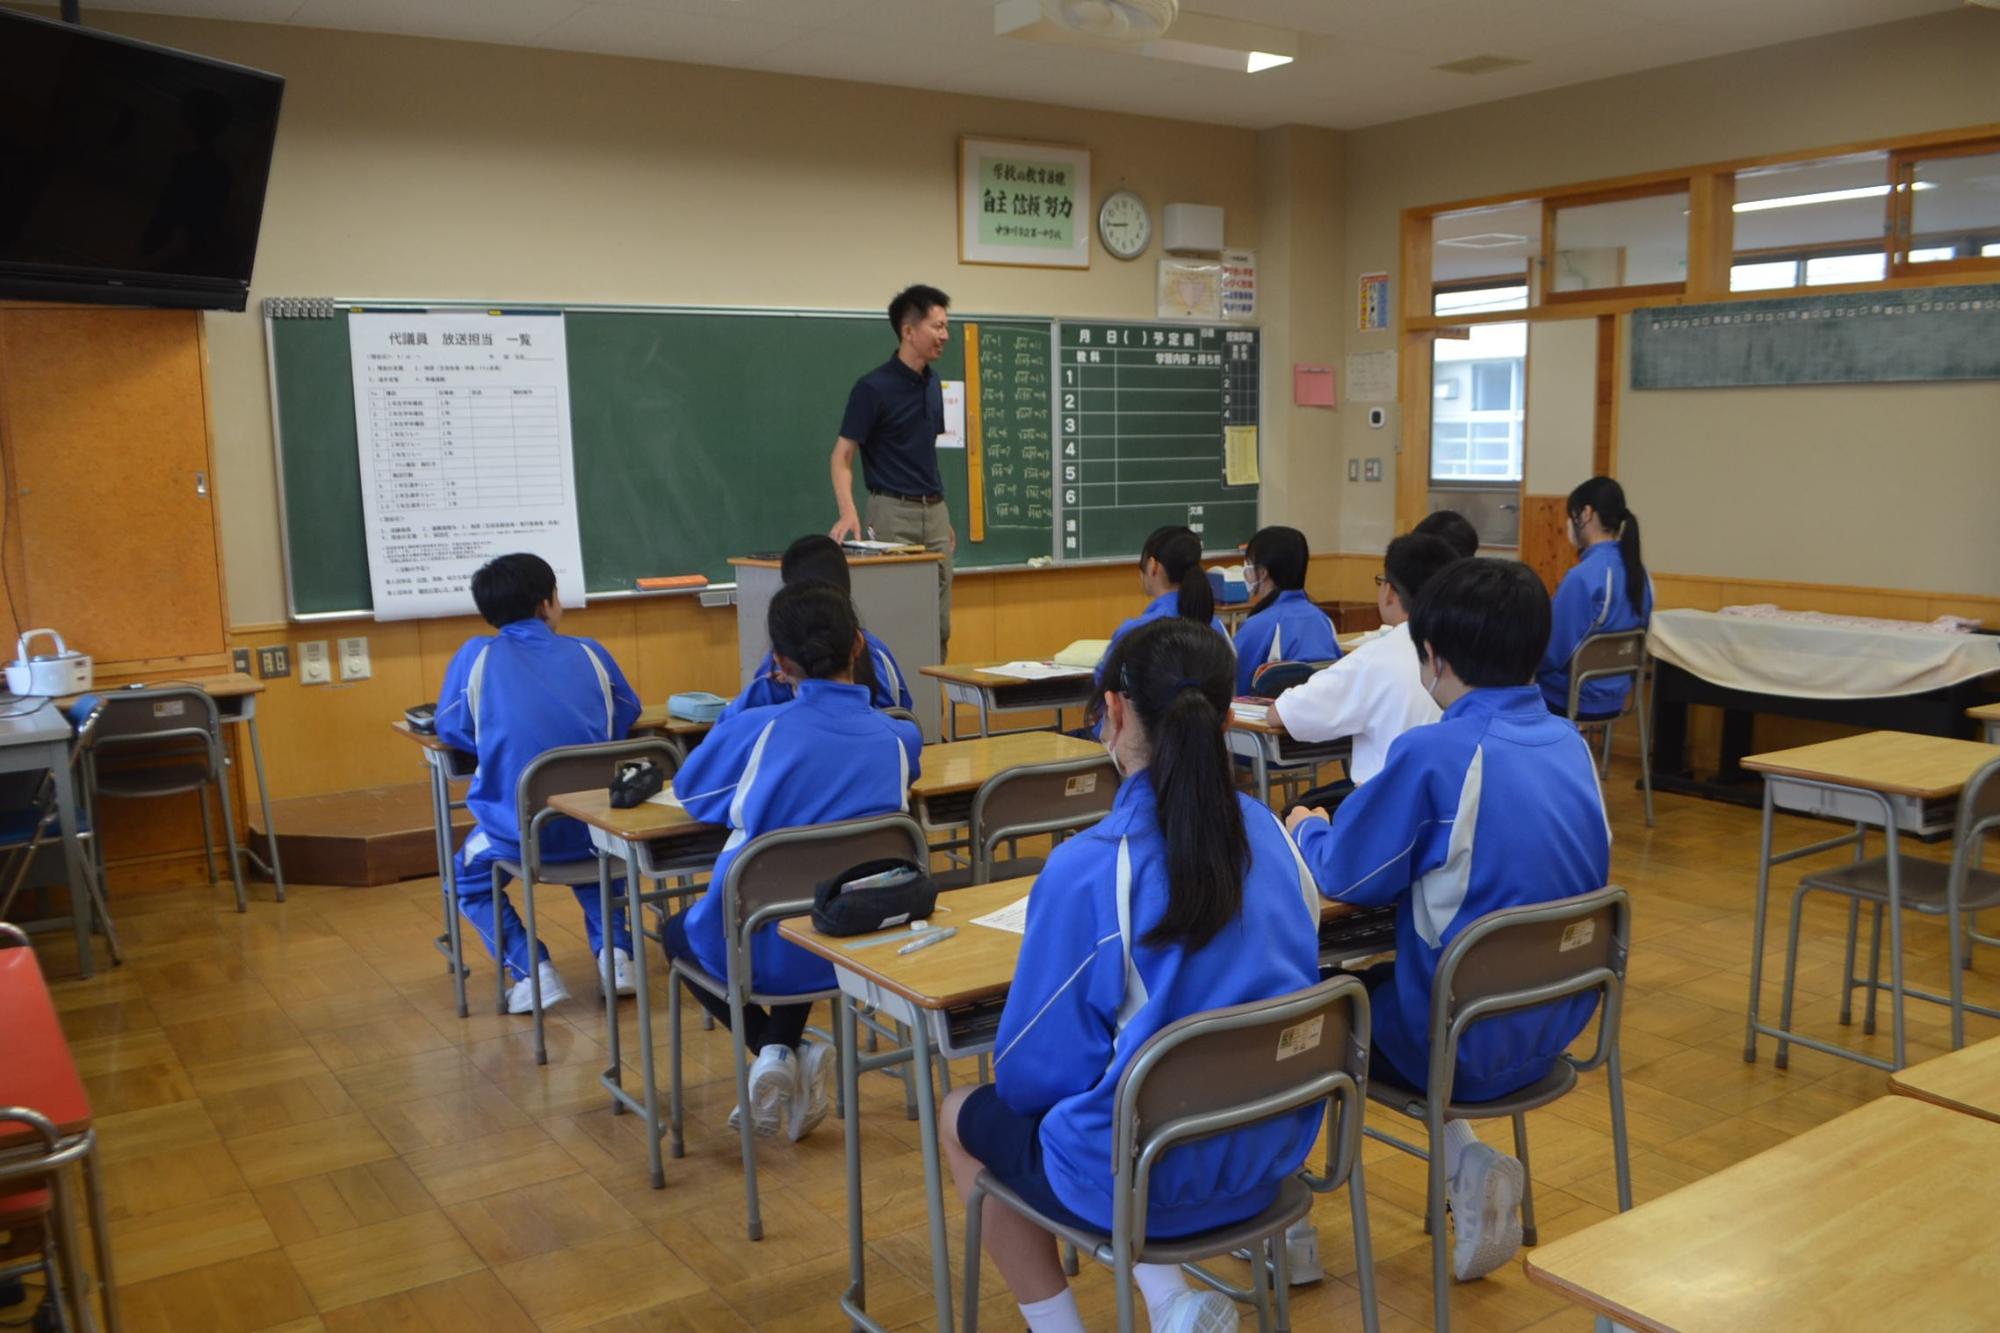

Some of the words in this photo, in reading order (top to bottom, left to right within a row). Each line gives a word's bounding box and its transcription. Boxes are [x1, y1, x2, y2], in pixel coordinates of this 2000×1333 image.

[984, 187, 1008, 213] 自主
[1013, 192, 1041, 217] 信頼
[1044, 195, 1073, 219] 努力
[389, 332, 428, 346] 代議員
[442, 332, 493, 346] 放送担当
[506, 333, 532, 346] 一覧
[1079, 329, 1090, 344] 月
[1076, 350, 1100, 363] 教科
[1066, 370, 1073, 384] 1
[1064, 394, 1075, 408] 2
[1065, 418, 1076, 432] 3
[1065, 442, 1075, 456] 4
[1065, 466, 1076, 480] 5
[1065, 490, 1076, 504] 6
